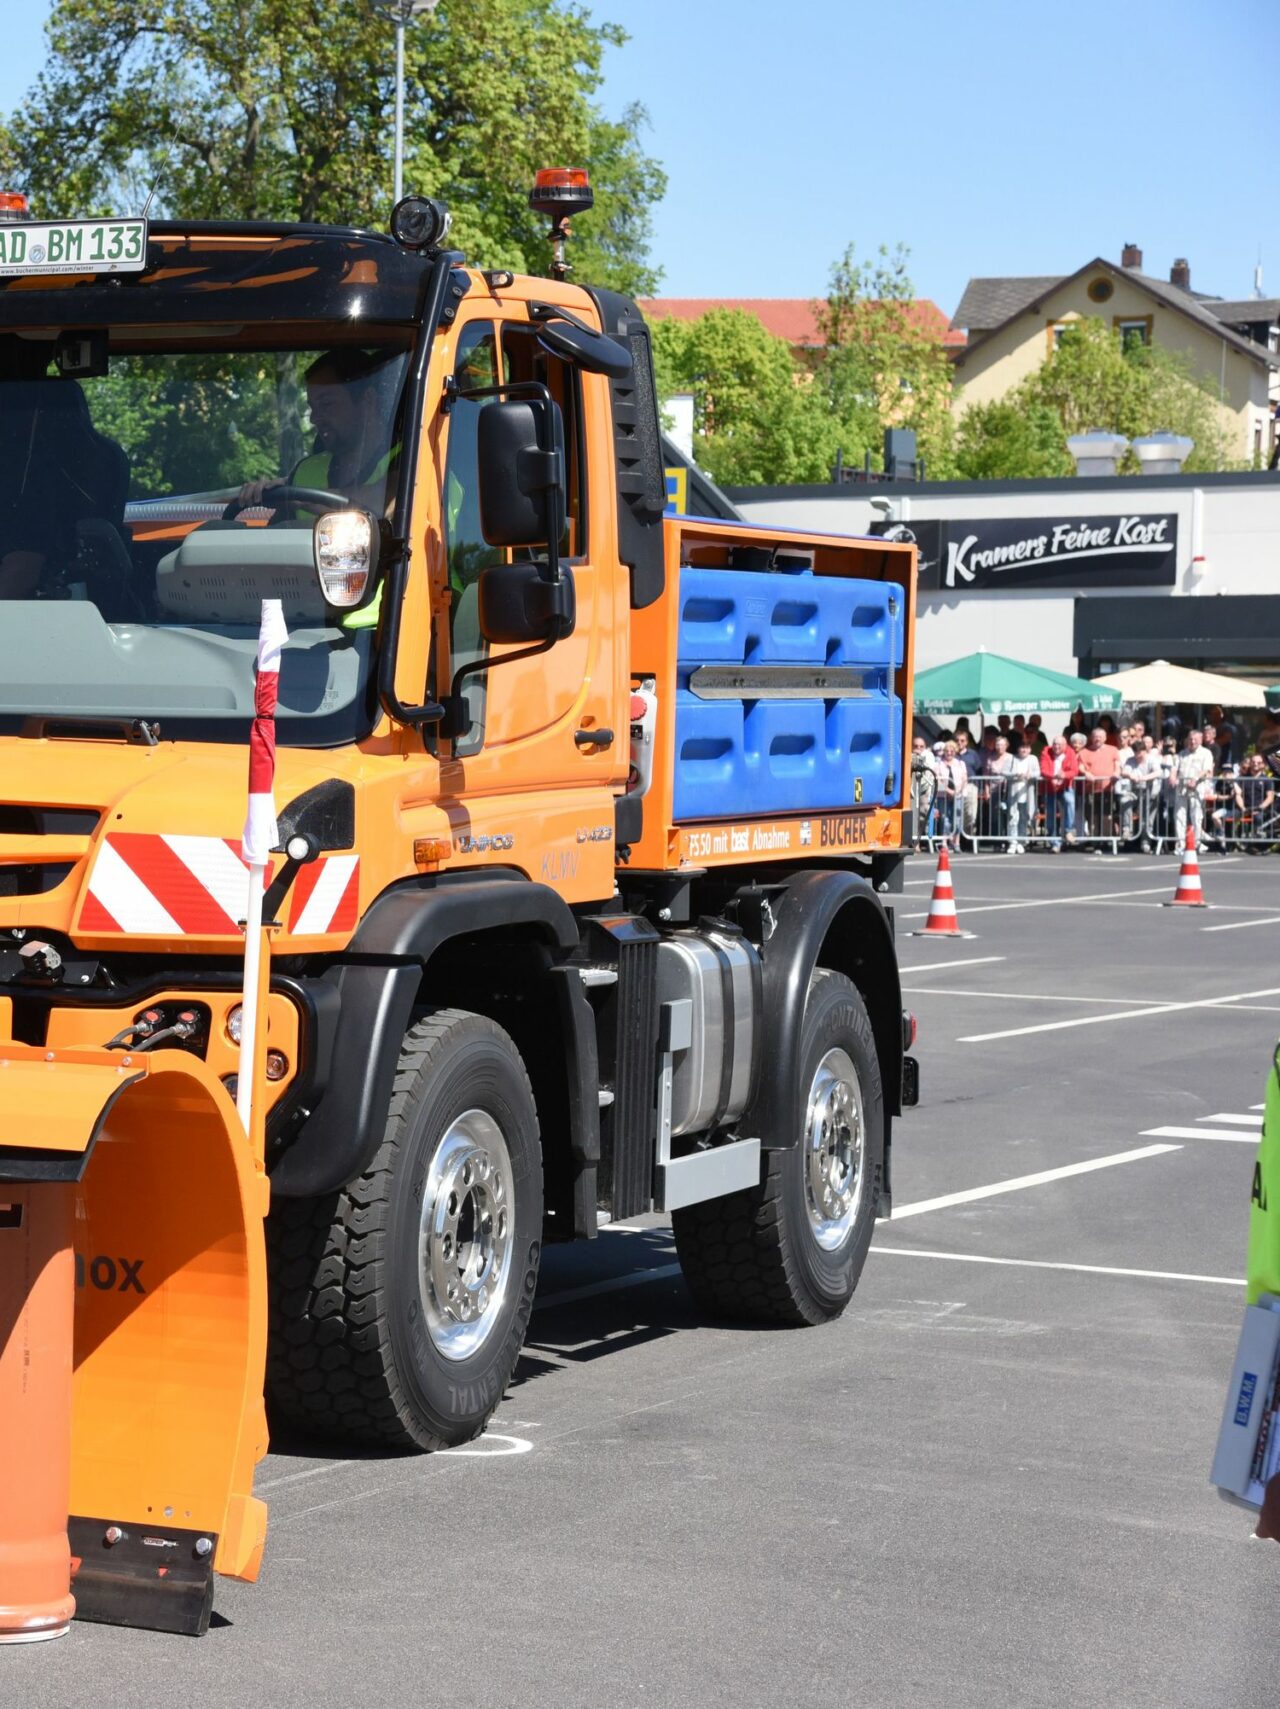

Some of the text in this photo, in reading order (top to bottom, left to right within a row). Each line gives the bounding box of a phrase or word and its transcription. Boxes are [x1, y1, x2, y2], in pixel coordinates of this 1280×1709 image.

[47, 228, 84, 262] BM
[89, 225, 142, 260] 133
[946, 516, 1169, 587] Kramers Feine Kost
[713, 829, 727, 854] mit
[753, 828, 789, 849] Abnahme
[820, 817, 867, 847] BUCHER
[1236, 1377, 1255, 1424] B.W.M.
